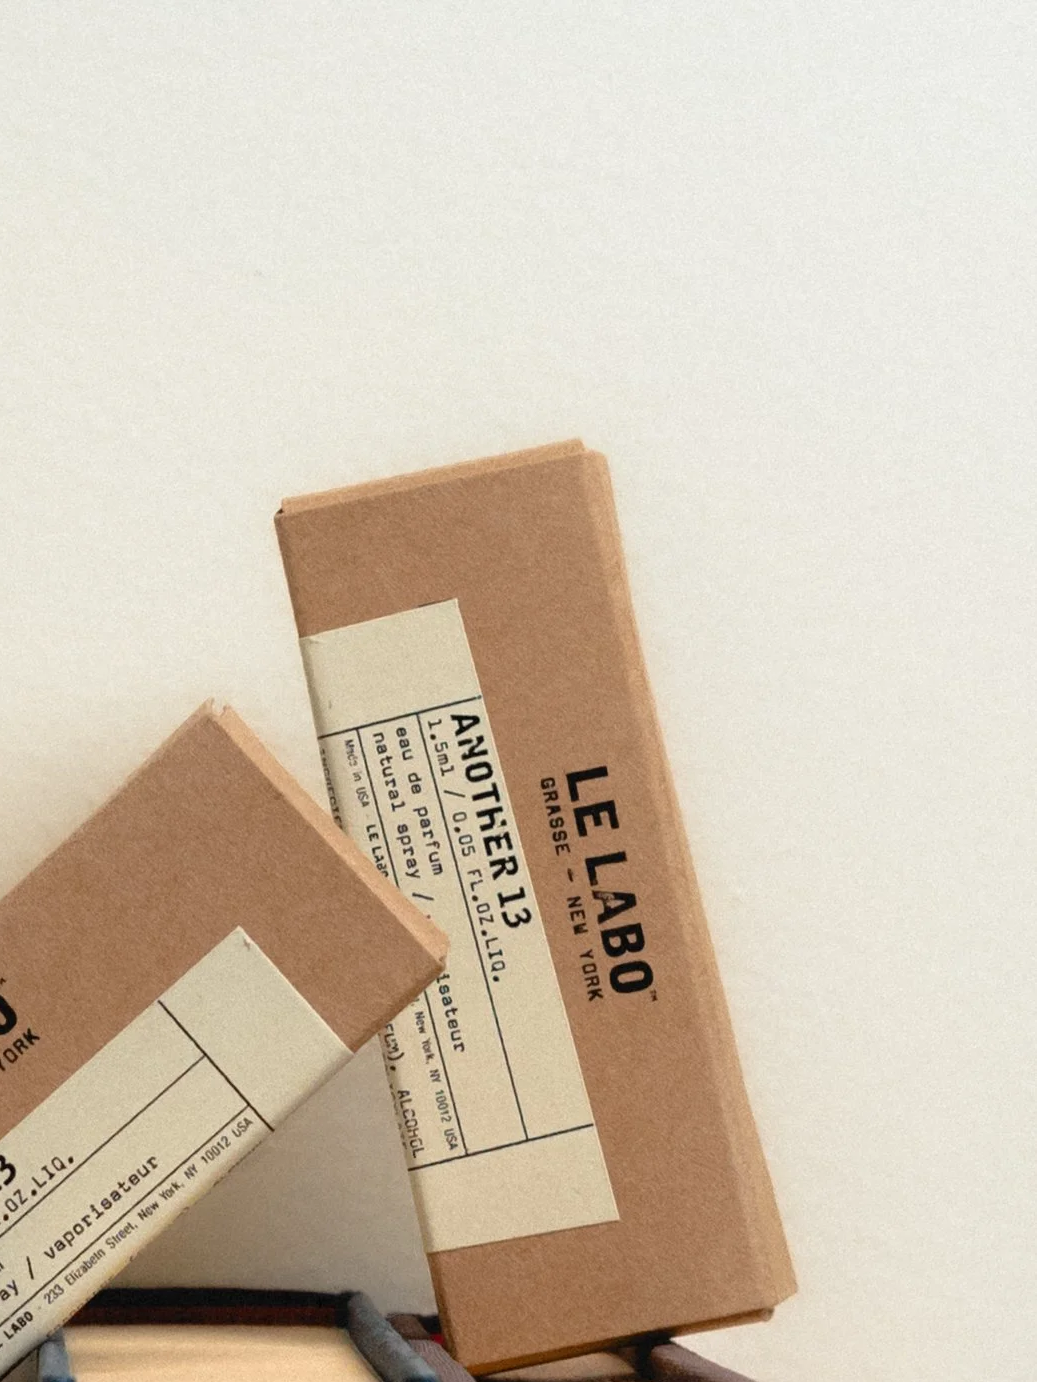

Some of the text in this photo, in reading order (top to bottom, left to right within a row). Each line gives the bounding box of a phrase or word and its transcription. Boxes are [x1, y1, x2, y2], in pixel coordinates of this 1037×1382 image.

[351, 771, 362, 782] in
[354, 785, 370, 808] USA
[372, 731, 406, 812] natural
[395, 823, 421, 879] spray
[395, 726, 443, 876] eau de parfum
[426, 718, 455, 777] 1.5ml
[451, 810, 476, 857] 0.05
[564, 764, 620, 837] LE
[365, 823, 379, 842] LE
[449, 713, 532, 928] ANOTHER 13
[539, 776, 571, 856] GRASSE
[566, 895, 588, 935] NEW
[578, 948, 604, 1002] YORK
[414, 1010, 426, 1034] New
[428, 1068, 441, 1082] NY
[434, 1088, 452, 1123] 10012
[443, 1127, 458, 1151] USA
[2, 1310, 33, 1340] LABO
[42, 1283, 64, 1305] 233
[136, 1200, 159, 1221] New
[183, 1163, 198, 1179] NY
[199, 1135, 231, 1164] 10012
[230, 1116, 253, 1138] USA
[42, 1155, 158, 1259] vaporisateur
